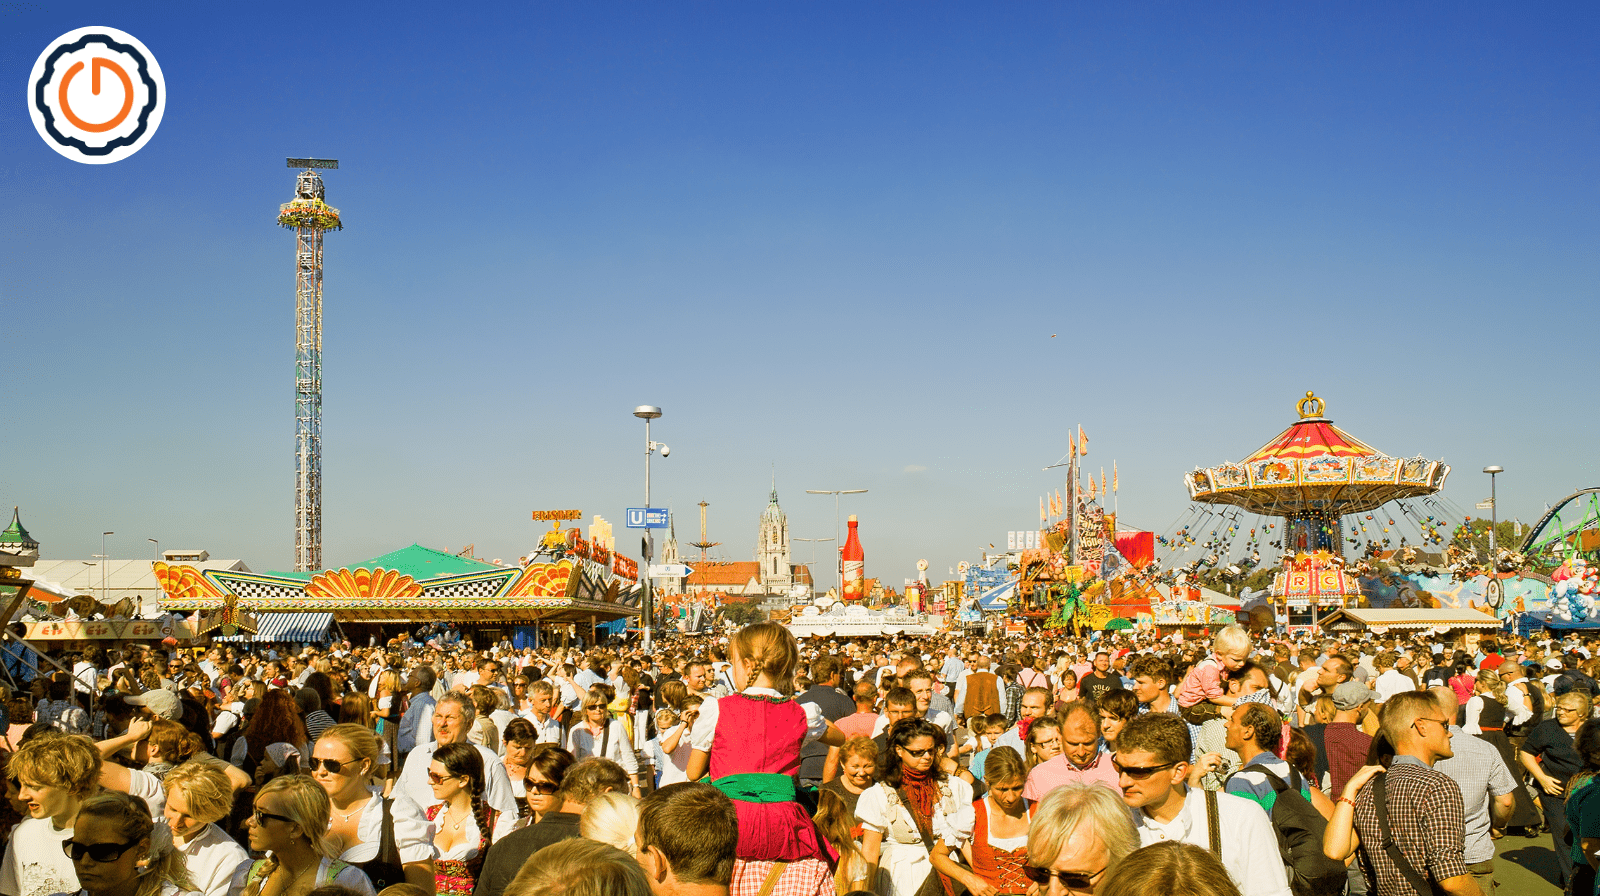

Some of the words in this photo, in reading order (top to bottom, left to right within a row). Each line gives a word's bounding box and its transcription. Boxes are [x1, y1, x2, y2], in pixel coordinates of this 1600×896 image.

[532, 510, 582, 520] FRISBEE
[631, 511, 643, 524] U
[1077, 514, 1104, 530] Fahrt
[1080, 536, 1103, 548] Hölle
[1294, 576, 1305, 586] R
[1324, 576, 1335, 585] C
[41, 625, 63, 635] Eis
[86, 625, 109, 635] Eis
[132, 625, 155, 635] Eis
